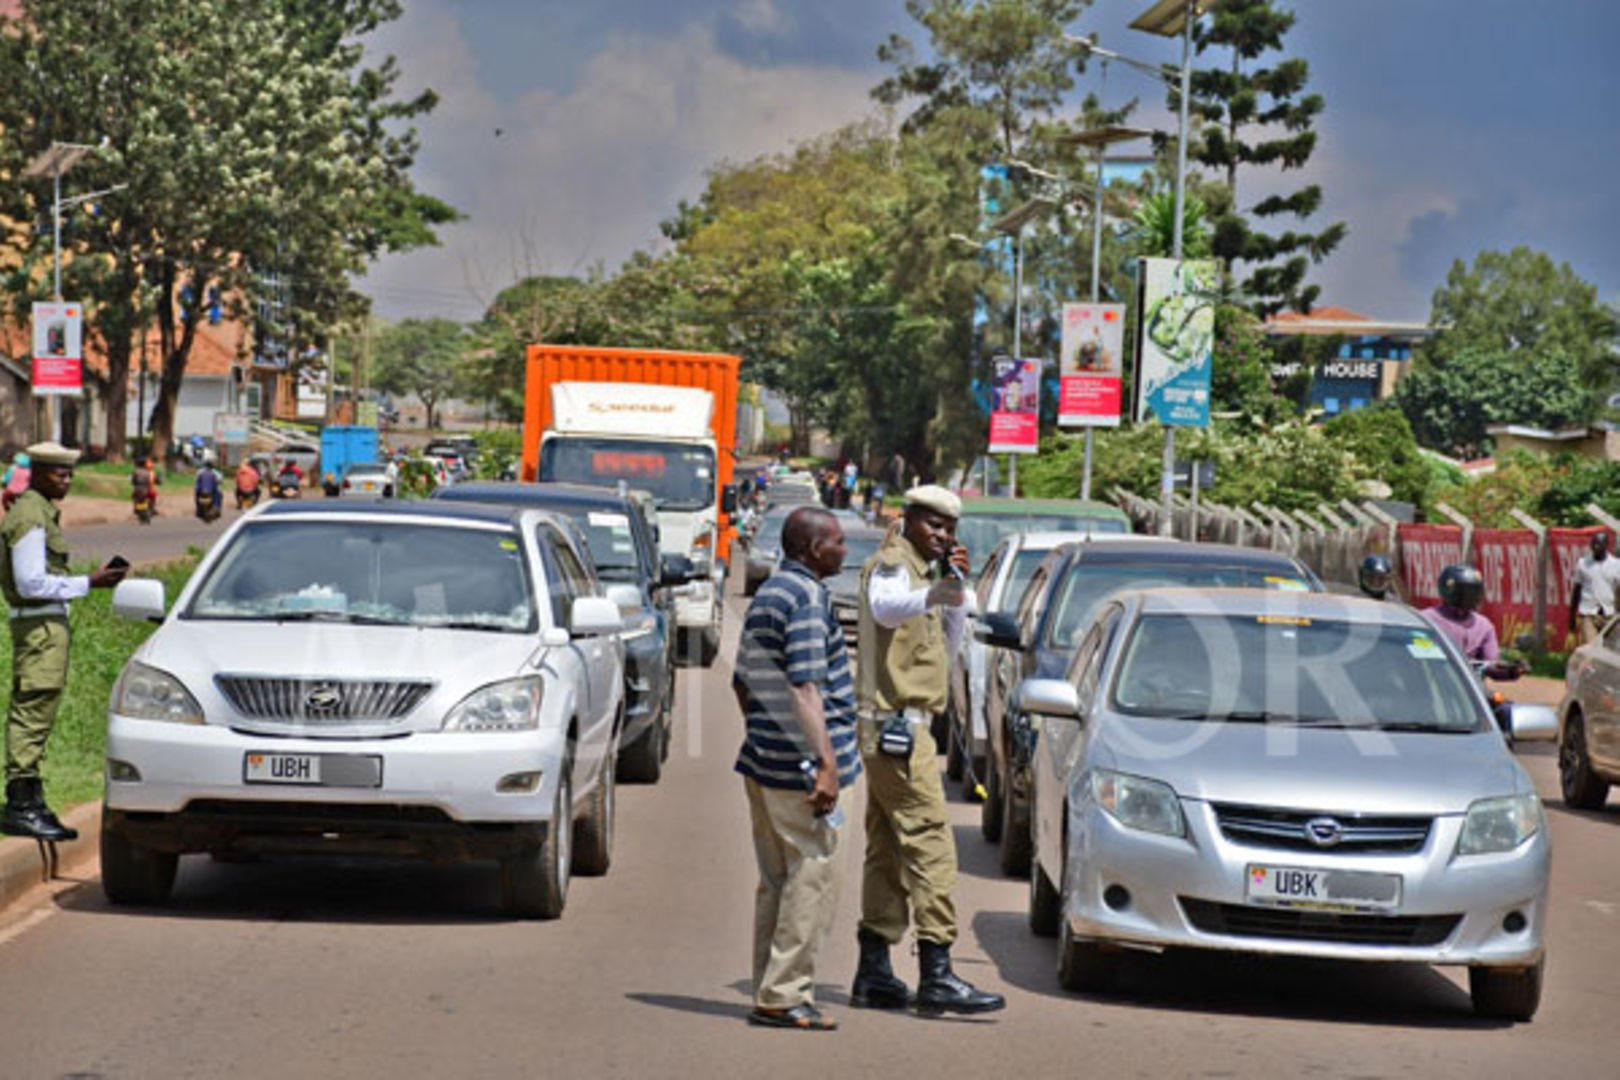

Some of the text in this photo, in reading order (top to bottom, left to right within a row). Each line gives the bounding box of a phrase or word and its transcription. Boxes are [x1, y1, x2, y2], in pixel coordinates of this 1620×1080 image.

[1323, 362, 1379, 379] HOUSE
[1482, 543, 1504, 604] OF
[271, 756, 311, 779] UBH
[1275, 870, 1318, 897] UBK
